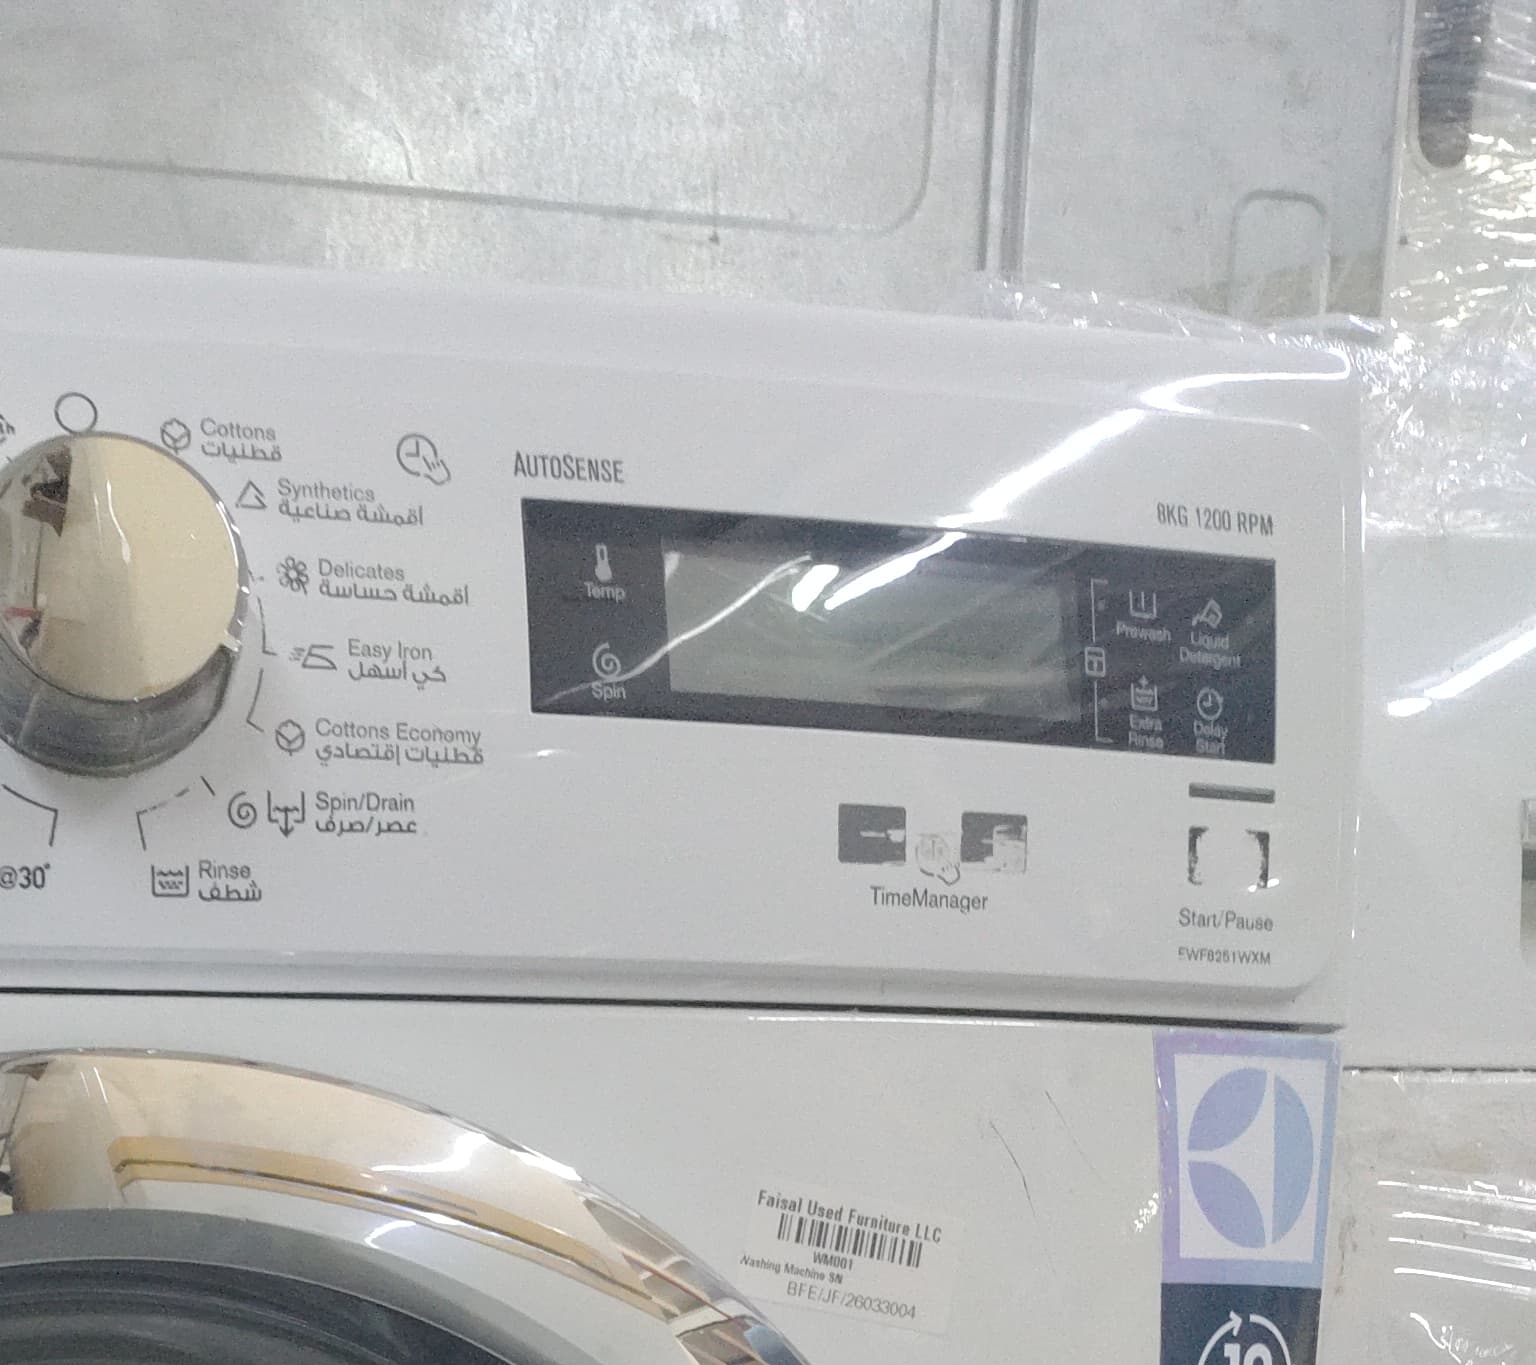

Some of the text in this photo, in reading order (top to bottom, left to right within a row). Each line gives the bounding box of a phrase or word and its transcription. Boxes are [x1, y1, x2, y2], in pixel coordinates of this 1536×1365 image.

[200, 417, 276, 441] Cottons
[514, 450, 624, 484] AUTOSENSE
[278, 478, 375, 502] Synthetics
[1157, 503, 1273, 536] 8KG 1200 RPM
[318, 558, 405, 581] Delicates
[584, 582, 626, 602] Temp
[348, 638, 432, 663] Easy Iron
[1190, 631, 1229, 650] Liquid
[591, 683, 626, 700] Spin
[314, 717, 481, 745] Cottons Economy
[315, 790, 415, 815] Spin/Drain
[198, 860, 251, 881] Rinse
[870, 886, 988, 914] TimeManager
[1178, 908, 1274, 931] Start/Pause
[757, 1190, 942, 1244] Faisal Used Furniture LLC
